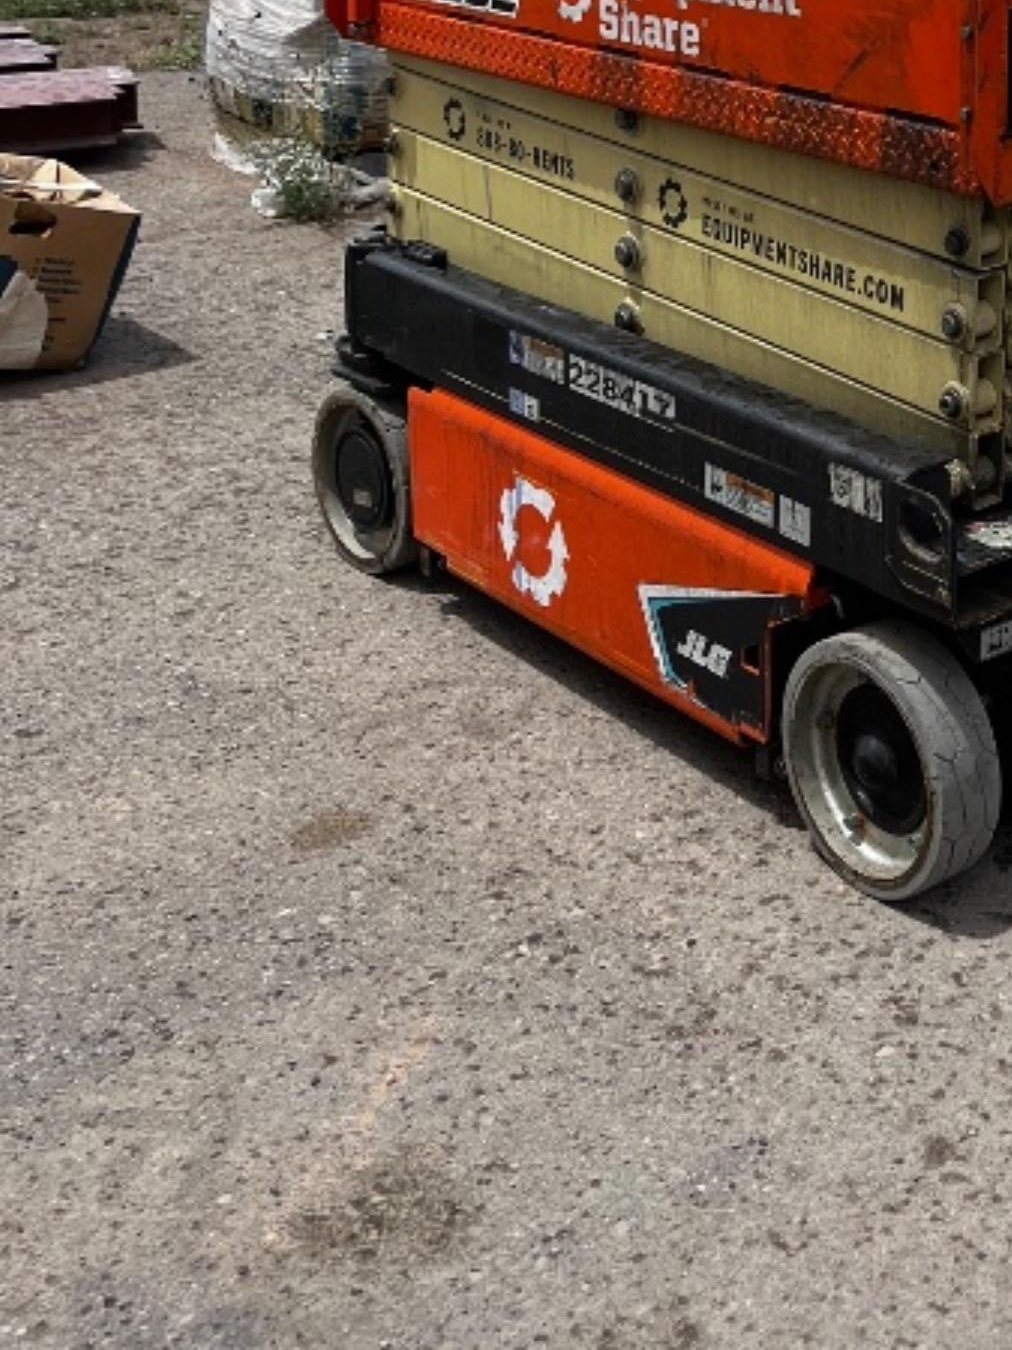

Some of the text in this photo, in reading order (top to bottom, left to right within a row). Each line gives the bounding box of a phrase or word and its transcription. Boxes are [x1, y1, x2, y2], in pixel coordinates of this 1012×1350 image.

[701, 215, 904, 312] EQUIPMENTSHARE.COM
[569, 362, 670, 417] 228417
[676, 629, 733, 679] JLG
